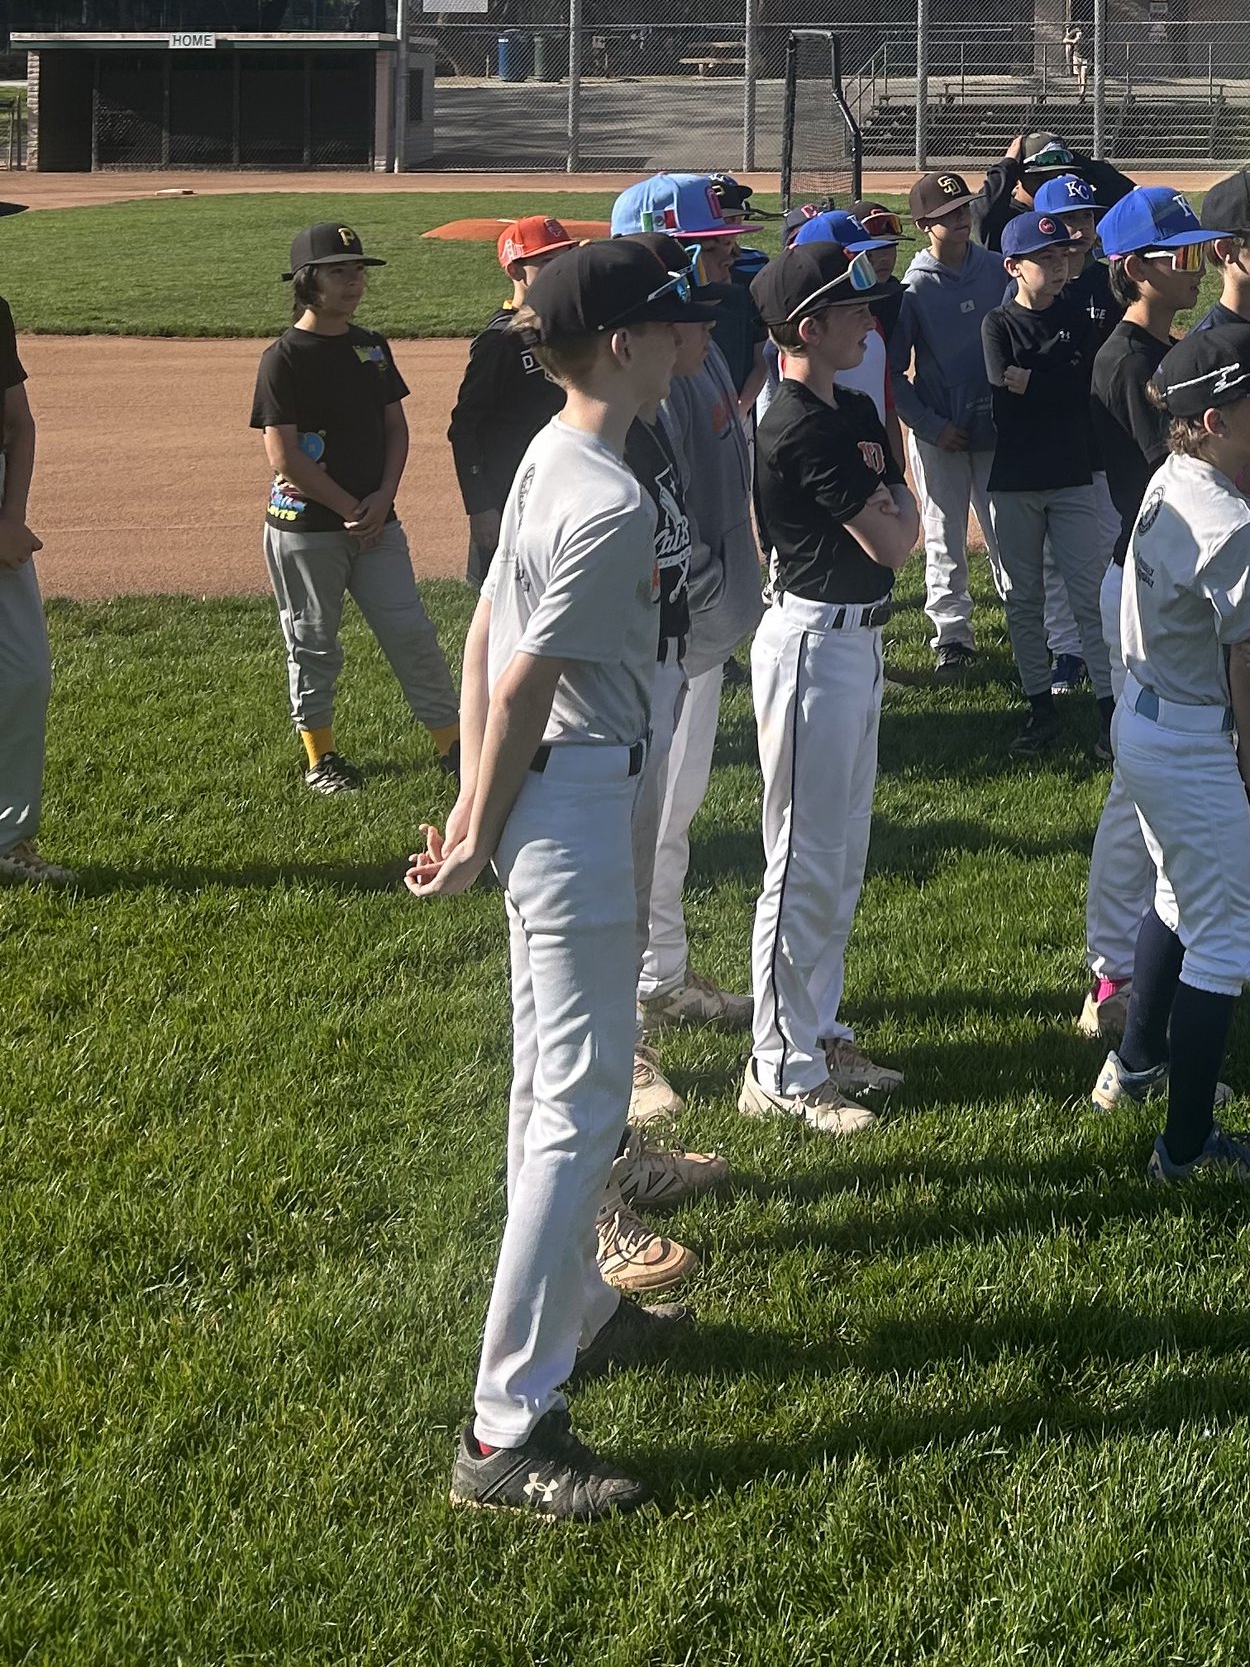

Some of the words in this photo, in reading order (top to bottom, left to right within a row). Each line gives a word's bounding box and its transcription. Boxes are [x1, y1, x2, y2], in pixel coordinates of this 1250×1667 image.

[172, 35, 213, 47] HOME
[1065, 180, 1090, 200] KC
[338, 227, 355, 246] P
